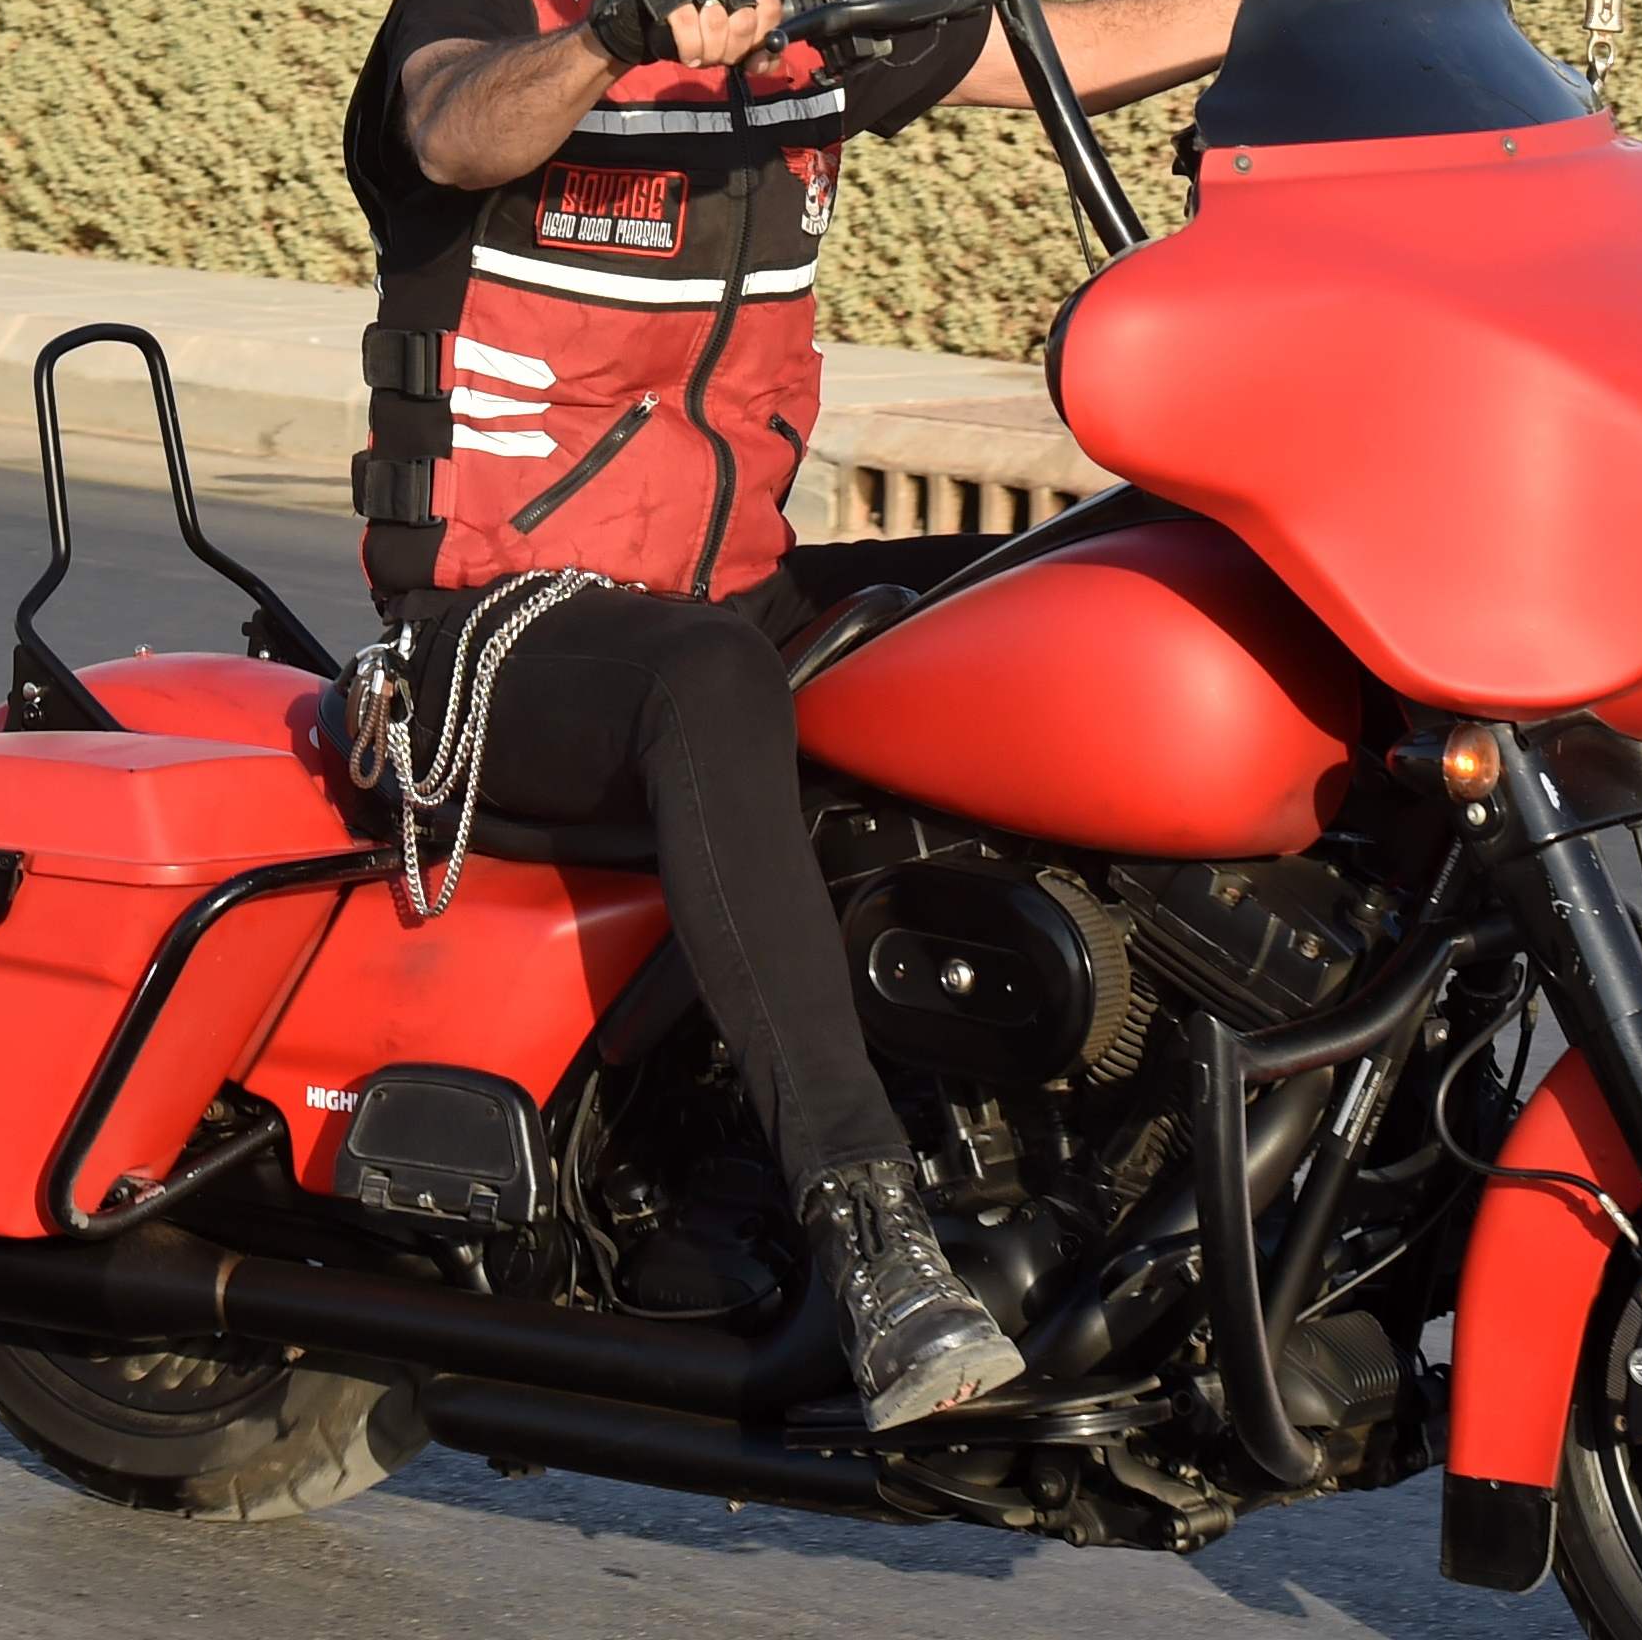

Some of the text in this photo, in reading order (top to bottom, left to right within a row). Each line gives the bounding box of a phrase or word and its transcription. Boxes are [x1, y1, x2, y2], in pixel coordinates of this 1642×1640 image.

[560, 170, 668, 220] SAVAGE
[541, 210, 674, 249] HEAD ROAD MARSHAL
[306, 1085, 359, 1113] HIGH
